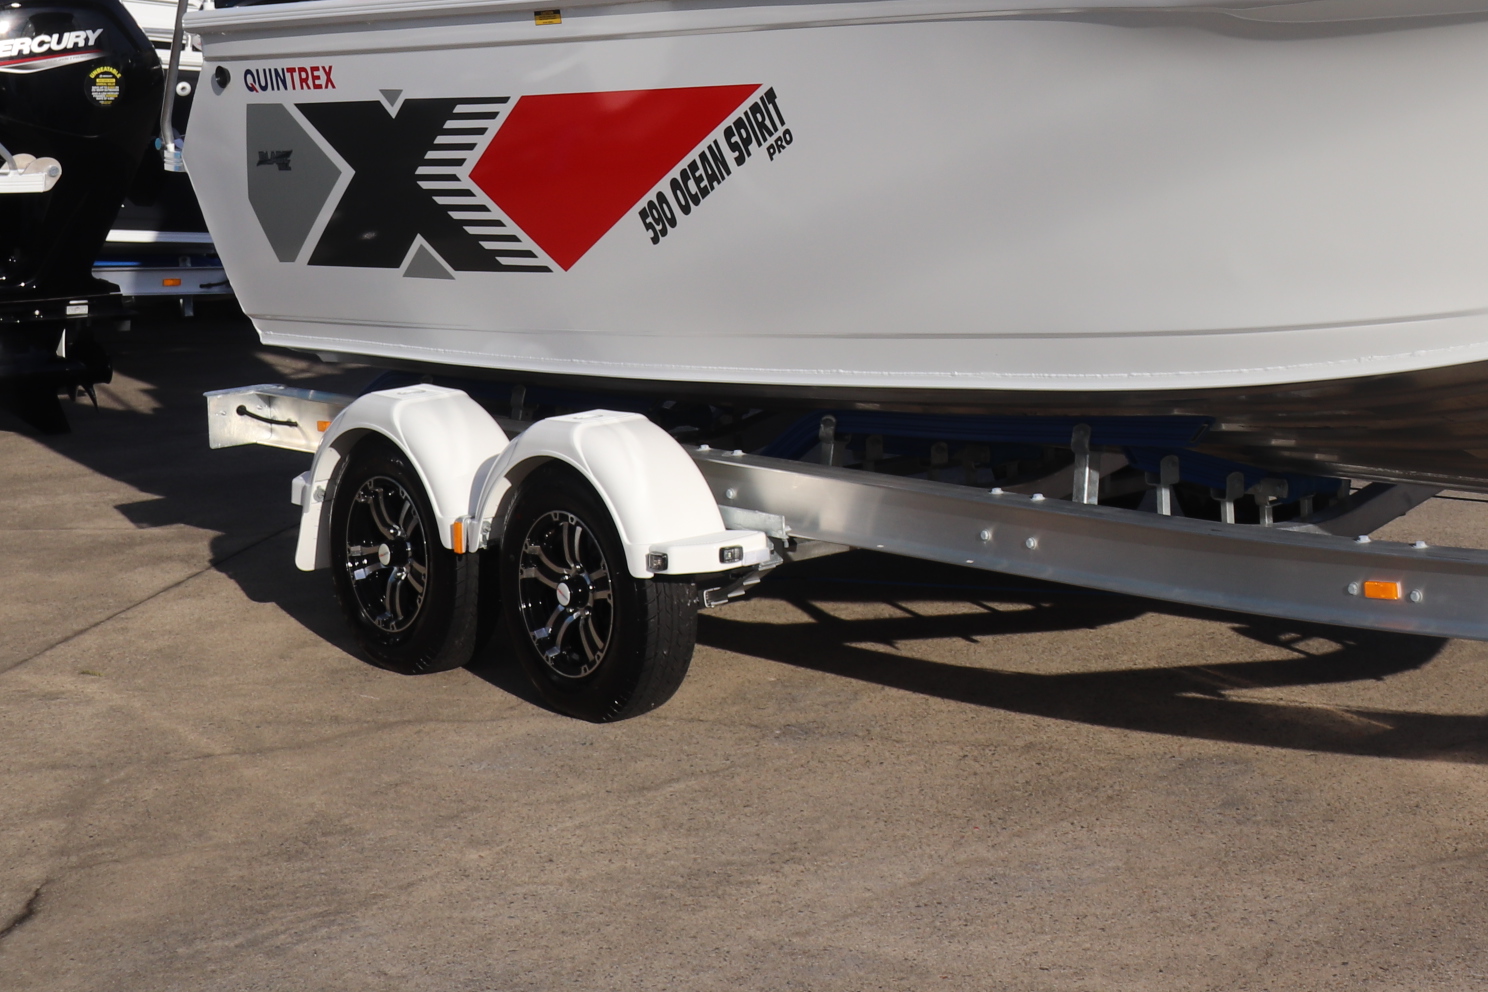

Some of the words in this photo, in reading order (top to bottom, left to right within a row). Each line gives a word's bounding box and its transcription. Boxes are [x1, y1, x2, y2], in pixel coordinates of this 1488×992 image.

[243, 65, 337, 93] QUINTREX
[766, 128, 794, 162] PRO
[638, 190, 678, 246] 590
[669, 138, 732, 217] OCEAN
[723, 86, 786, 168] SPIRIT
